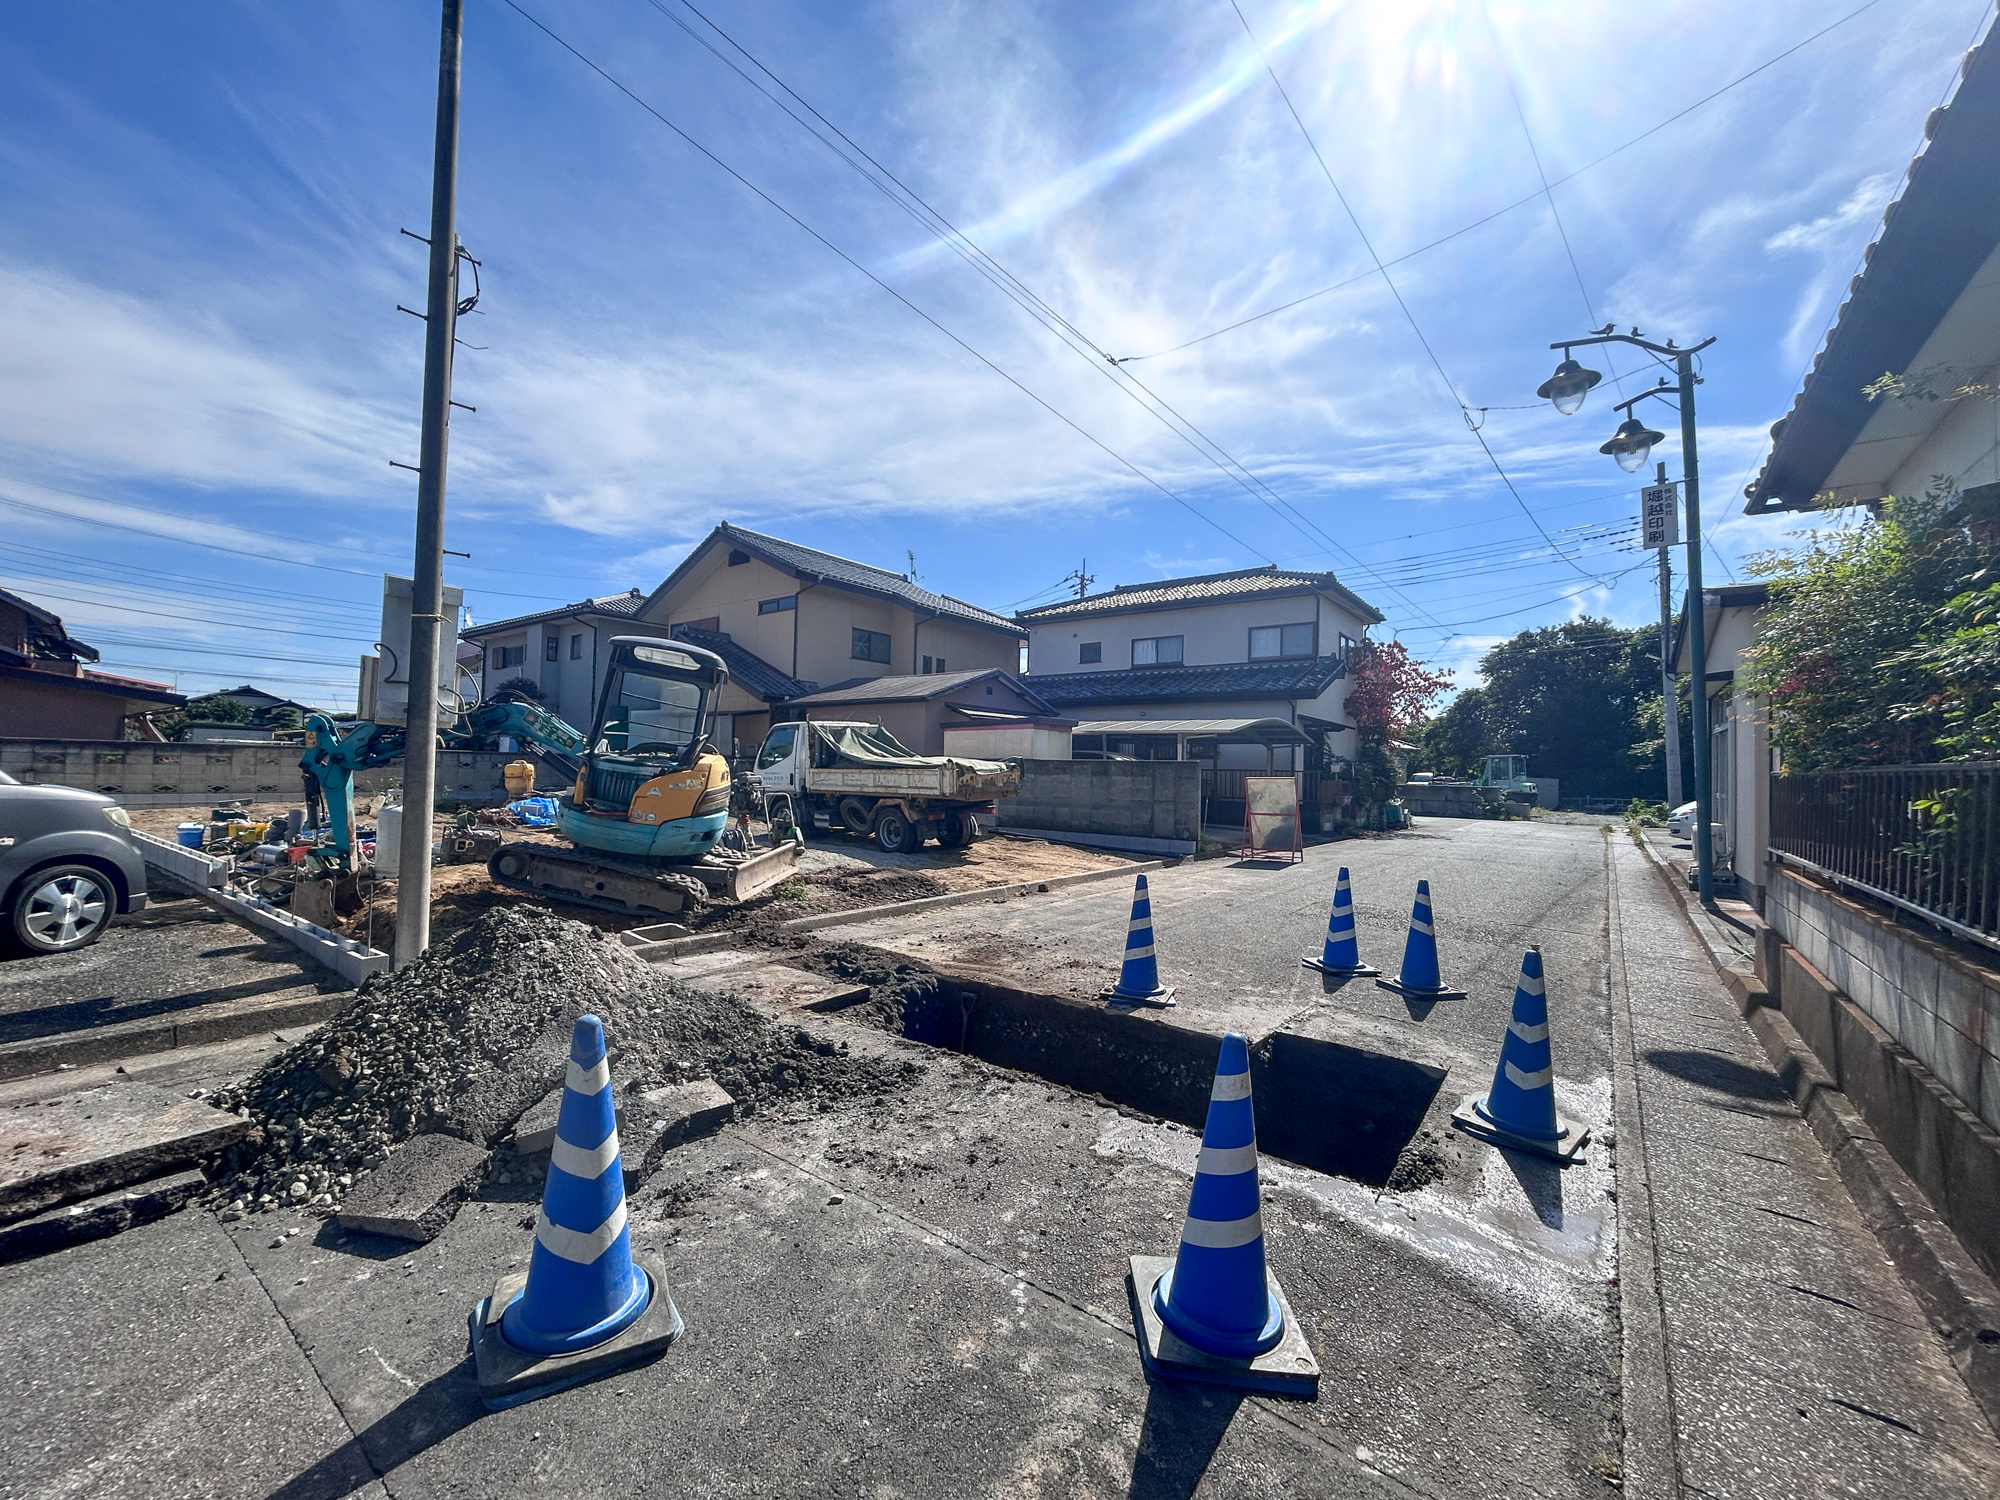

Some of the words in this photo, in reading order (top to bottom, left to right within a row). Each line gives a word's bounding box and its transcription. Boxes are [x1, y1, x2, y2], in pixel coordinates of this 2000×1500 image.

[1647, 489, 1664, 543] 堀越印刷
[1664, 488, 1673, 516] 株式会社
